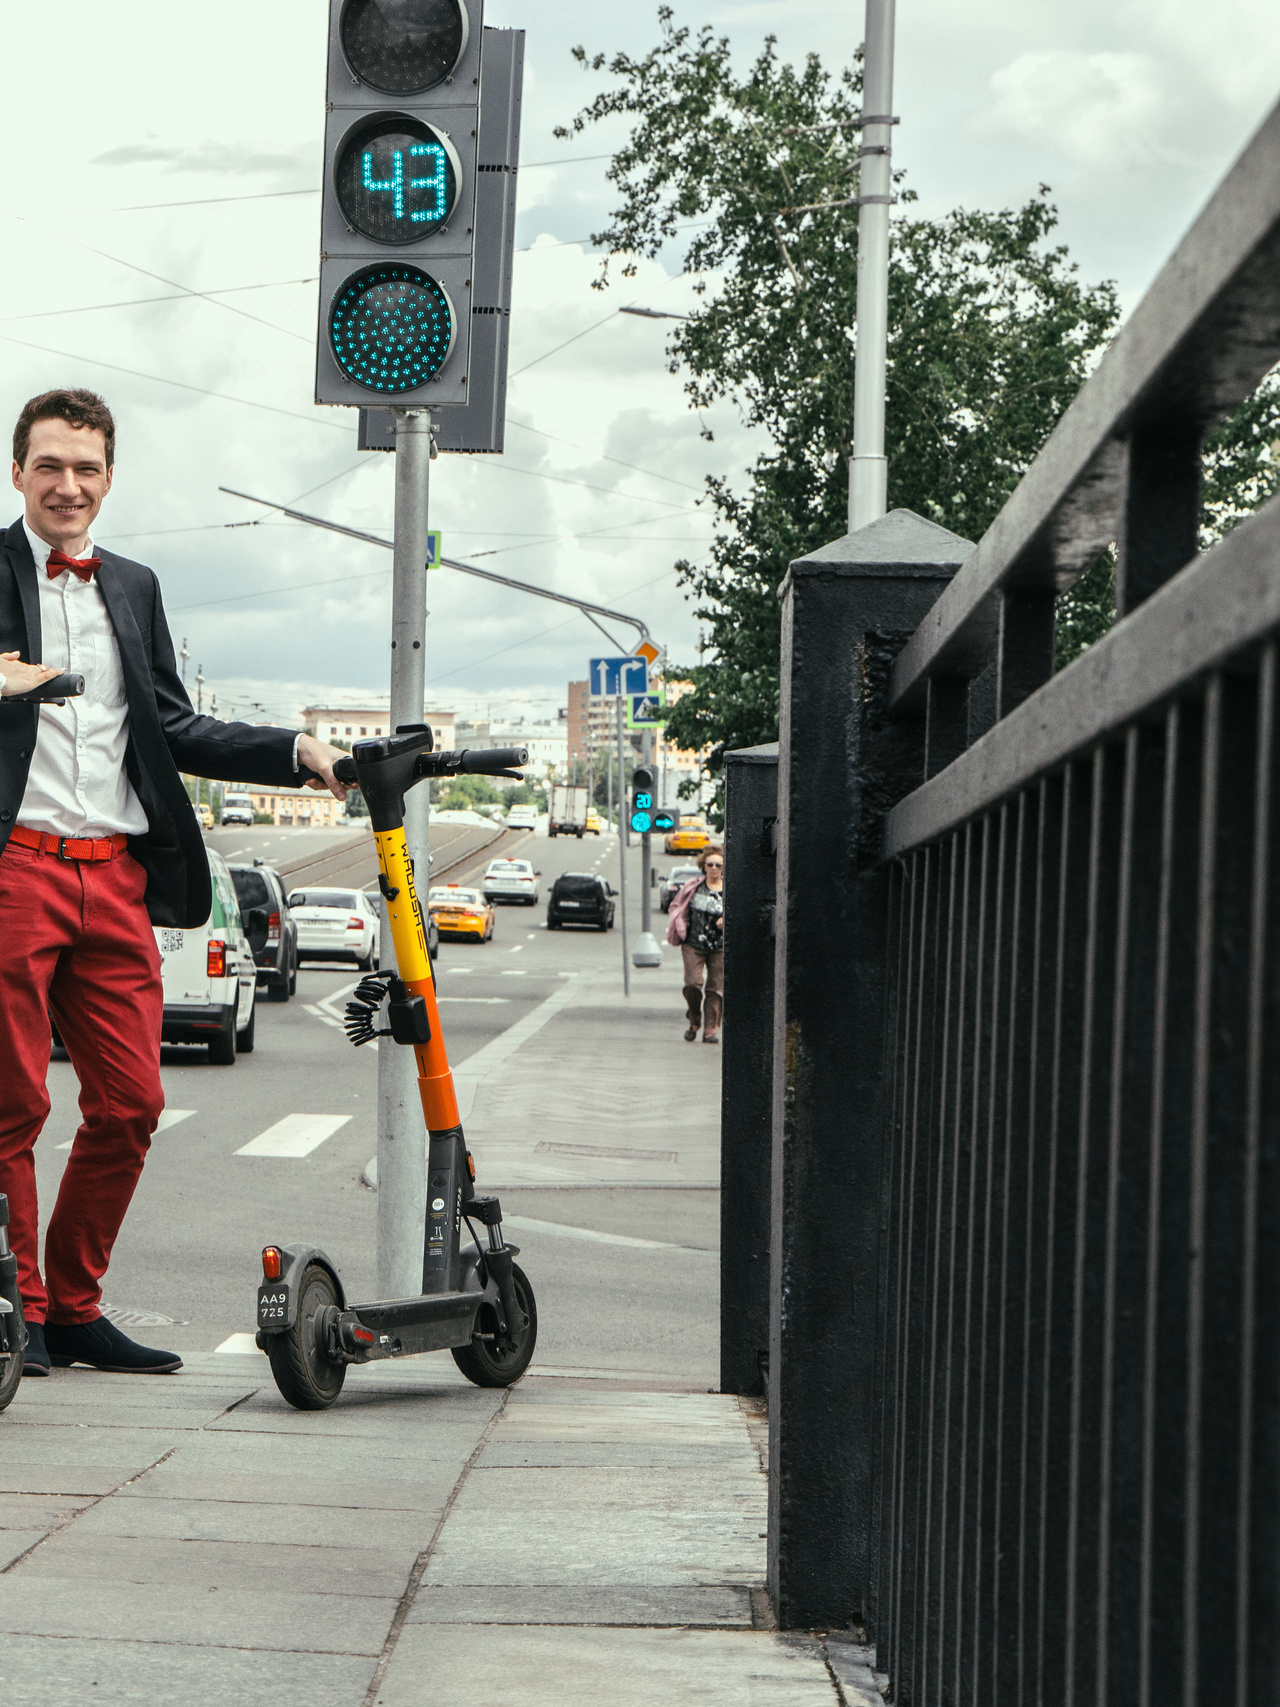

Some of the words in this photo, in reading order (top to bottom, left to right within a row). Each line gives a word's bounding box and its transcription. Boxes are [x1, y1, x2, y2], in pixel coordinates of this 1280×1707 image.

[362, 143, 446, 223] 43
[636, 793, 652, 809] 20
[401, 842, 423, 927] WHOOSH
[260, 1293, 286, 1305] AA9
[261, 1307, 284, 1318] 725
